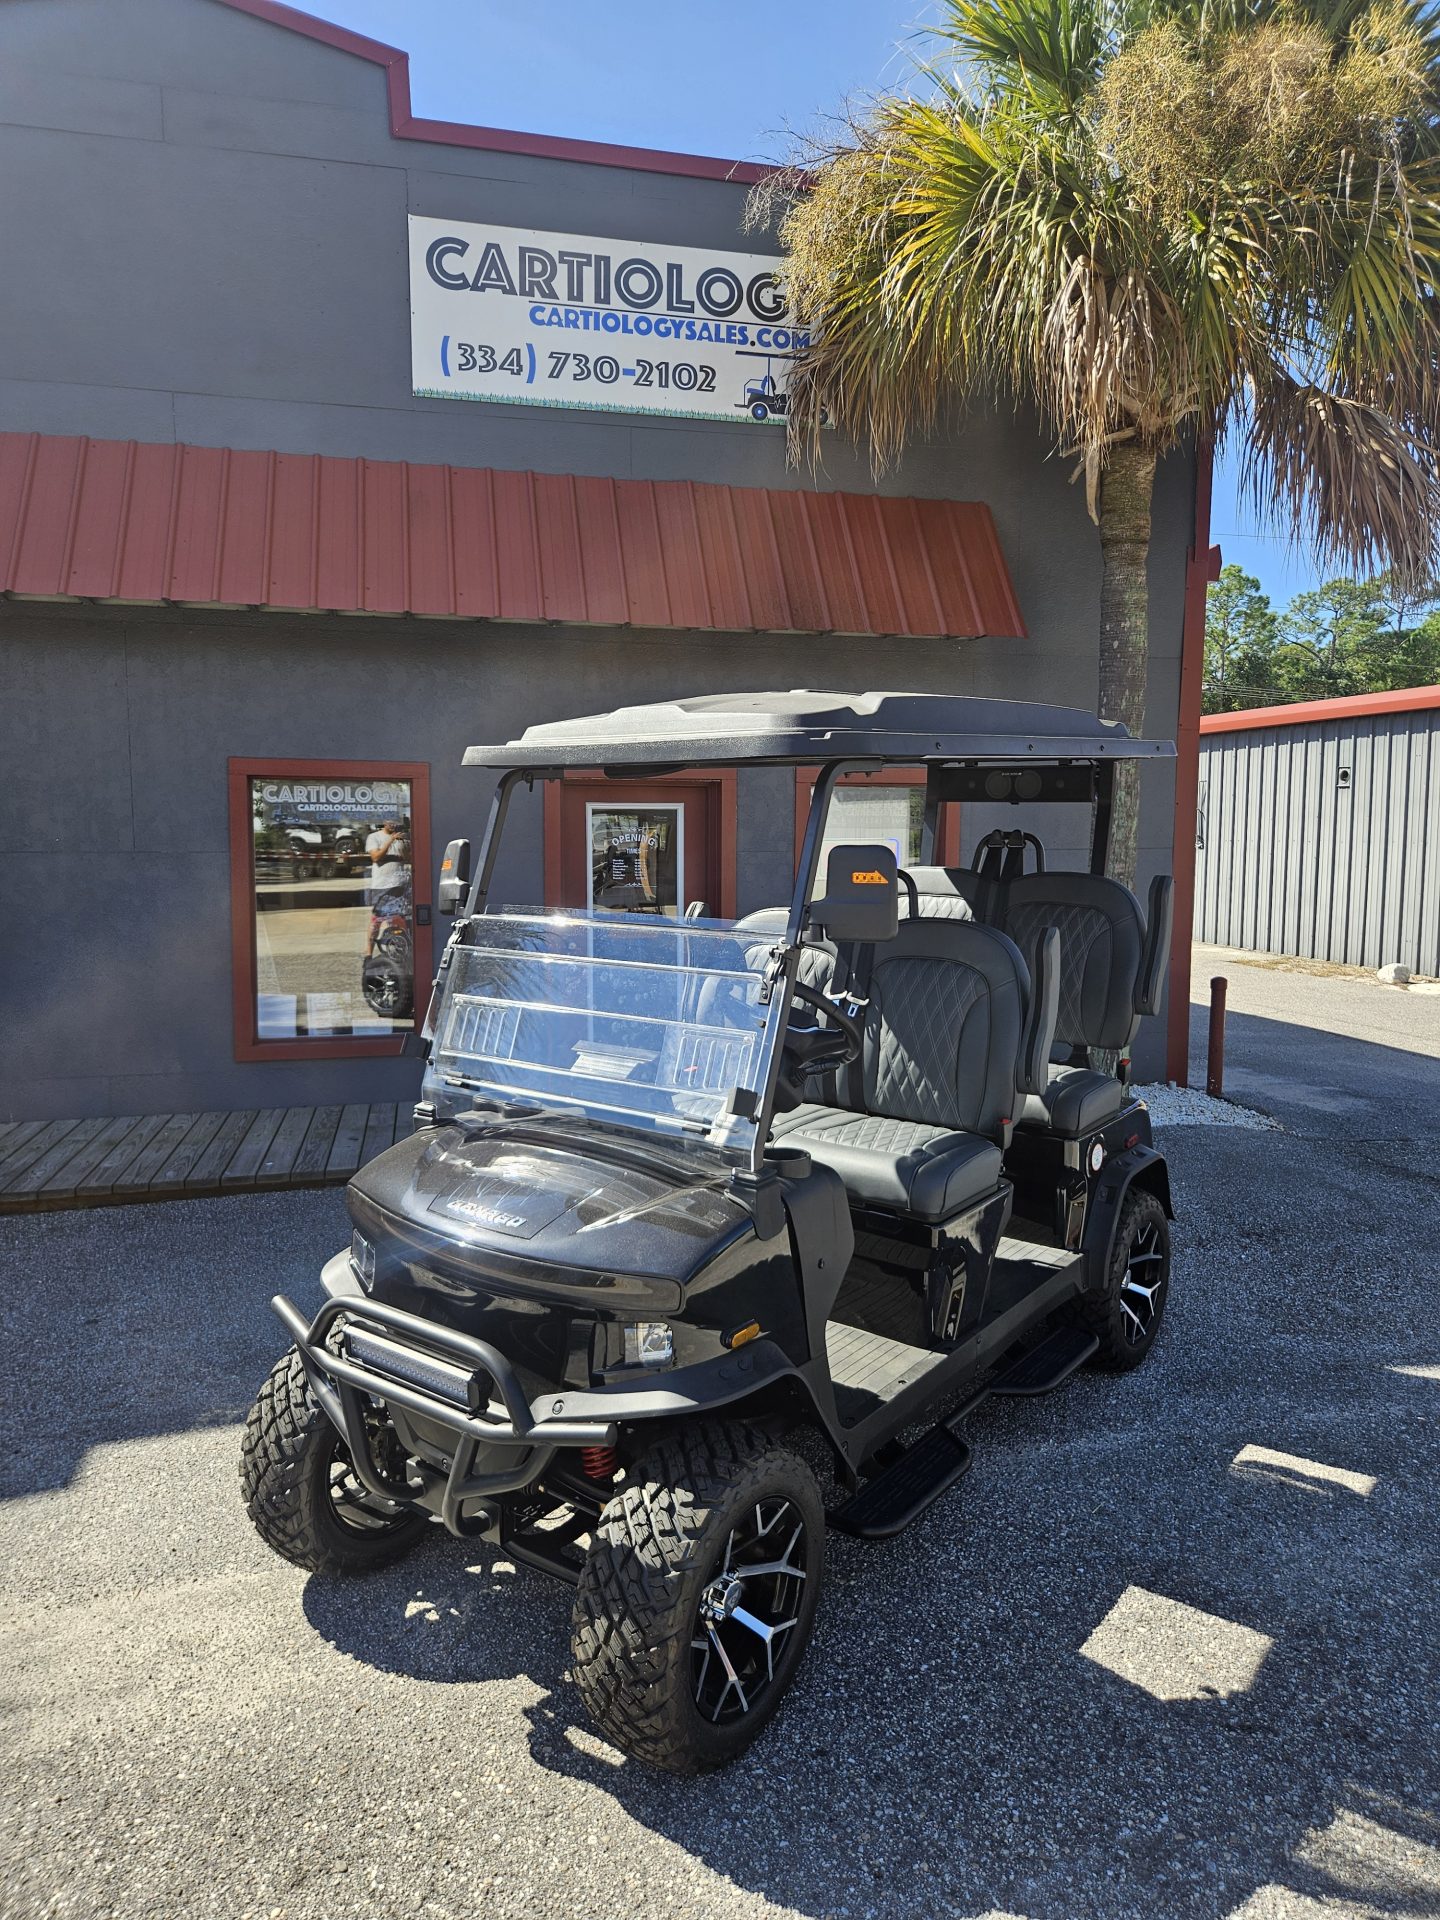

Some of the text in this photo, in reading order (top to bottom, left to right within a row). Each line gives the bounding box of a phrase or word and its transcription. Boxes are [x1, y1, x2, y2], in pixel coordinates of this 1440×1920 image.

[425, 236, 790, 323] CARTIOLOG
[528, 304, 811, 350] CARTIOLOGYSALES.COM
[440, 335, 717, 393] (334) 730-2102
[262, 784, 399, 804] CARTIOLOGY
[297, 803, 399, 812] CARTIOLOGYSALES.COM
[612, 833, 656, 846] OPENING
